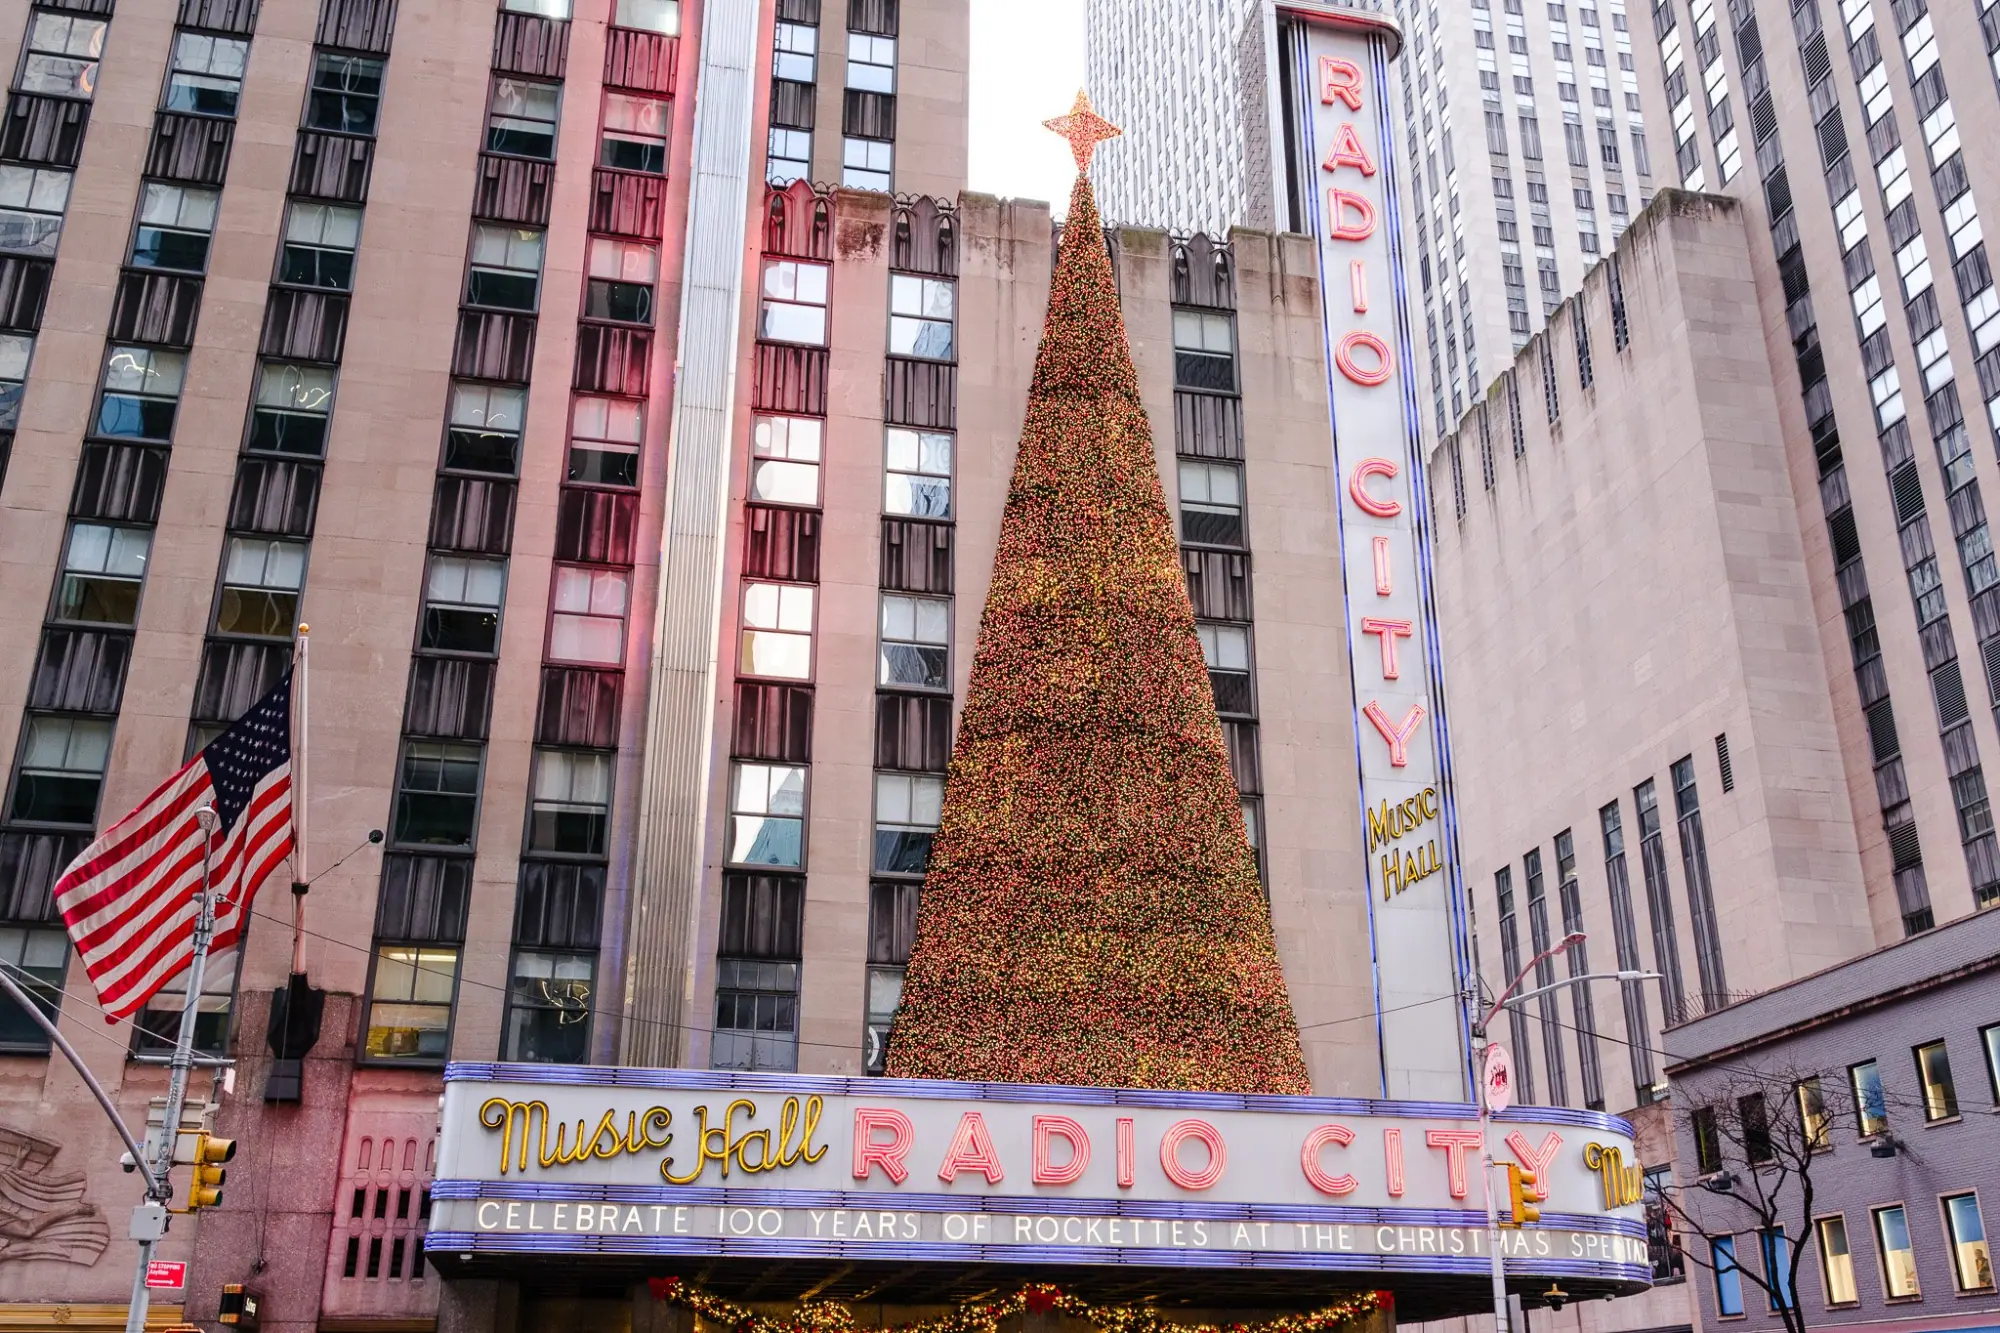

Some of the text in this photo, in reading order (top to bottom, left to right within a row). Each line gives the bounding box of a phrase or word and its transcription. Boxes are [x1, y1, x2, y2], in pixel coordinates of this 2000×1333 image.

[1318, 54, 1427, 768] RADIO CITY
[479, 1094, 829, 1185] Music Hall
[852, 1107, 1564, 1201] RADIO CITY
[478, 1202, 689, 1234] CELEBRATE
[718, 1208, 783, 1236] 100
[809, 1210, 918, 1240] YEARS
[943, 1213, 990, 1242] OF
[1014, 1216, 1209, 1247] ROCKETTES
[1233, 1222, 1268, 1249] AT
[1297, 1223, 1353, 1250] THE
[1377, 1226, 1550, 1256] CHRISTMAS
